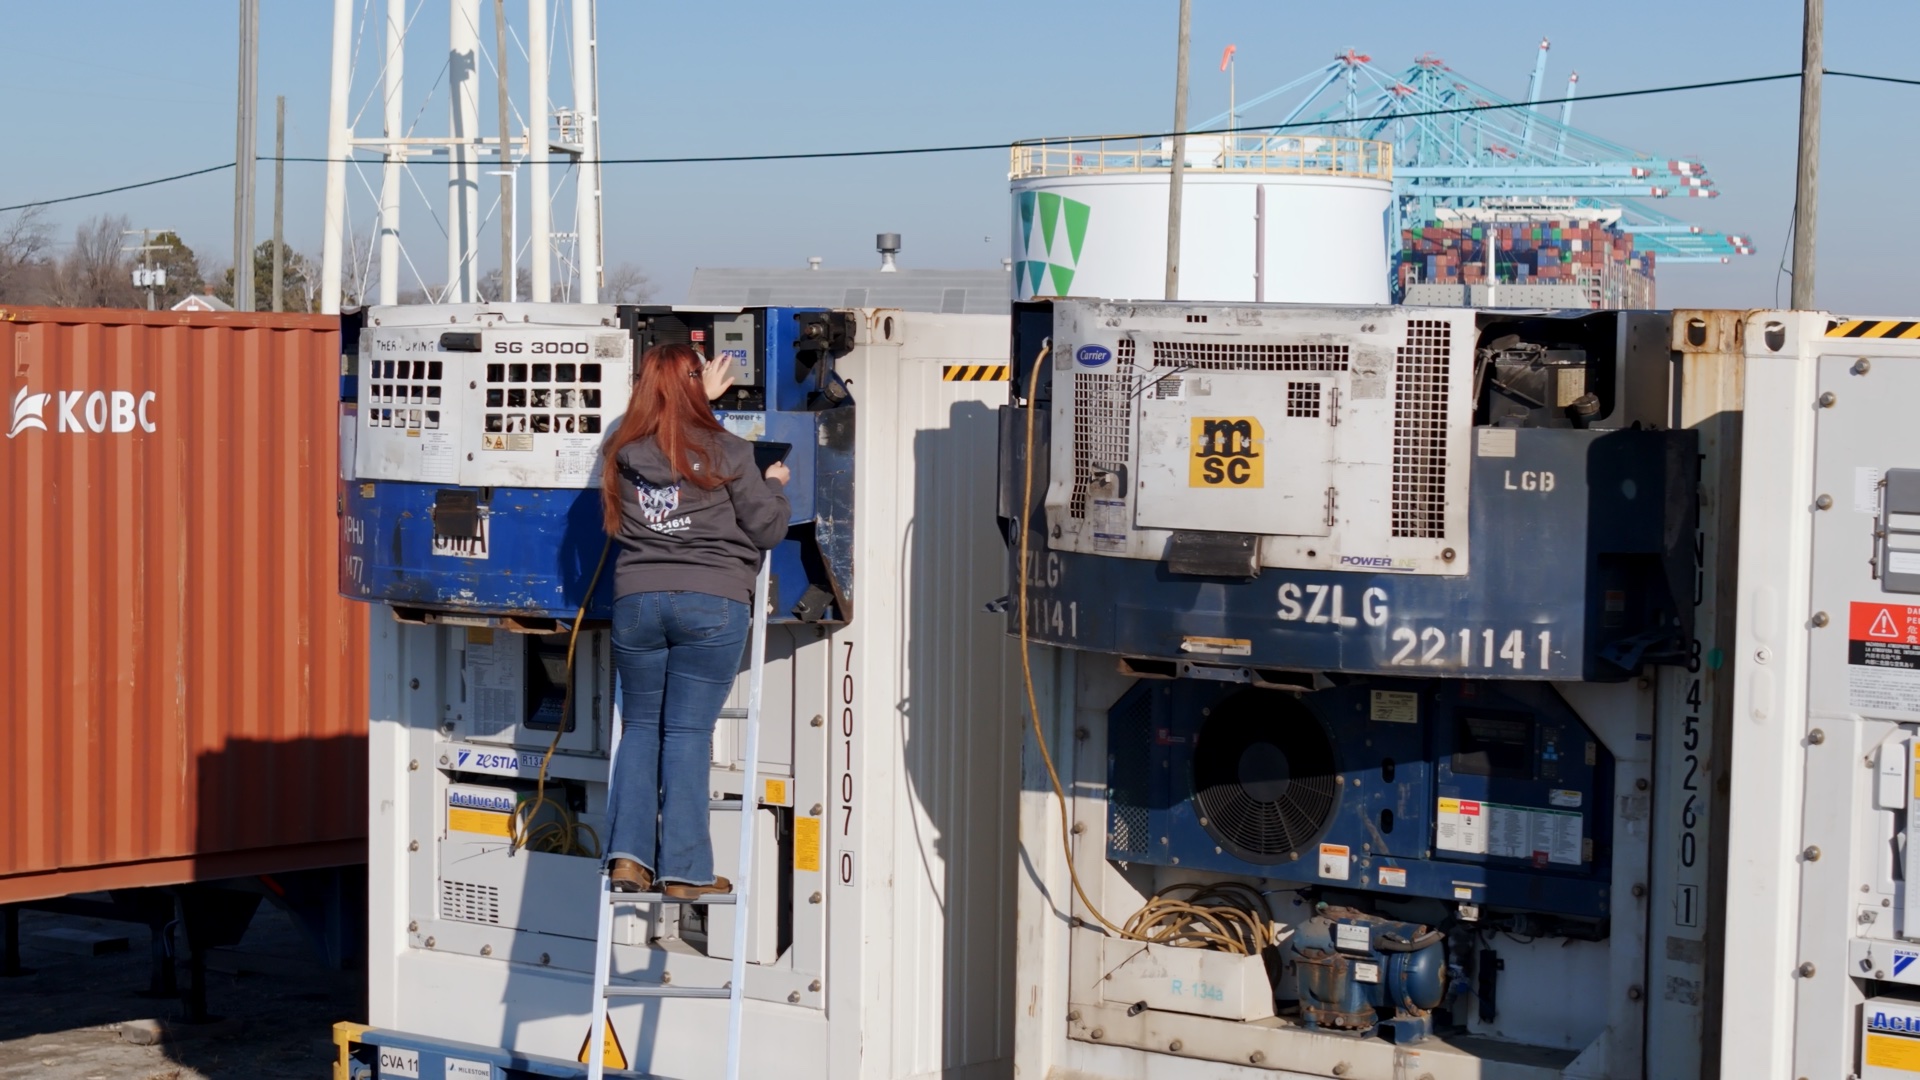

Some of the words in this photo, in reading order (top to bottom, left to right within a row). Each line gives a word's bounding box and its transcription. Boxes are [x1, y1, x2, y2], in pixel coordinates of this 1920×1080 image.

[495, 342, 522, 354] SG
[531, 342, 589, 354] 3000
[1080, 350, 1107, 361] Carrier
[58, 390, 157, 433] KOBC
[1504, 470, 1555, 492] LGB
[1277, 582, 1389, 627] SZLG
[1391, 627, 1550, 670] 221141
[522, 755, 550, 769] R134
[381, 1054, 404, 1070] CVA
[408, 1058, 418, 1072] 11
[458, 1067, 489, 1077] MILESTONE
